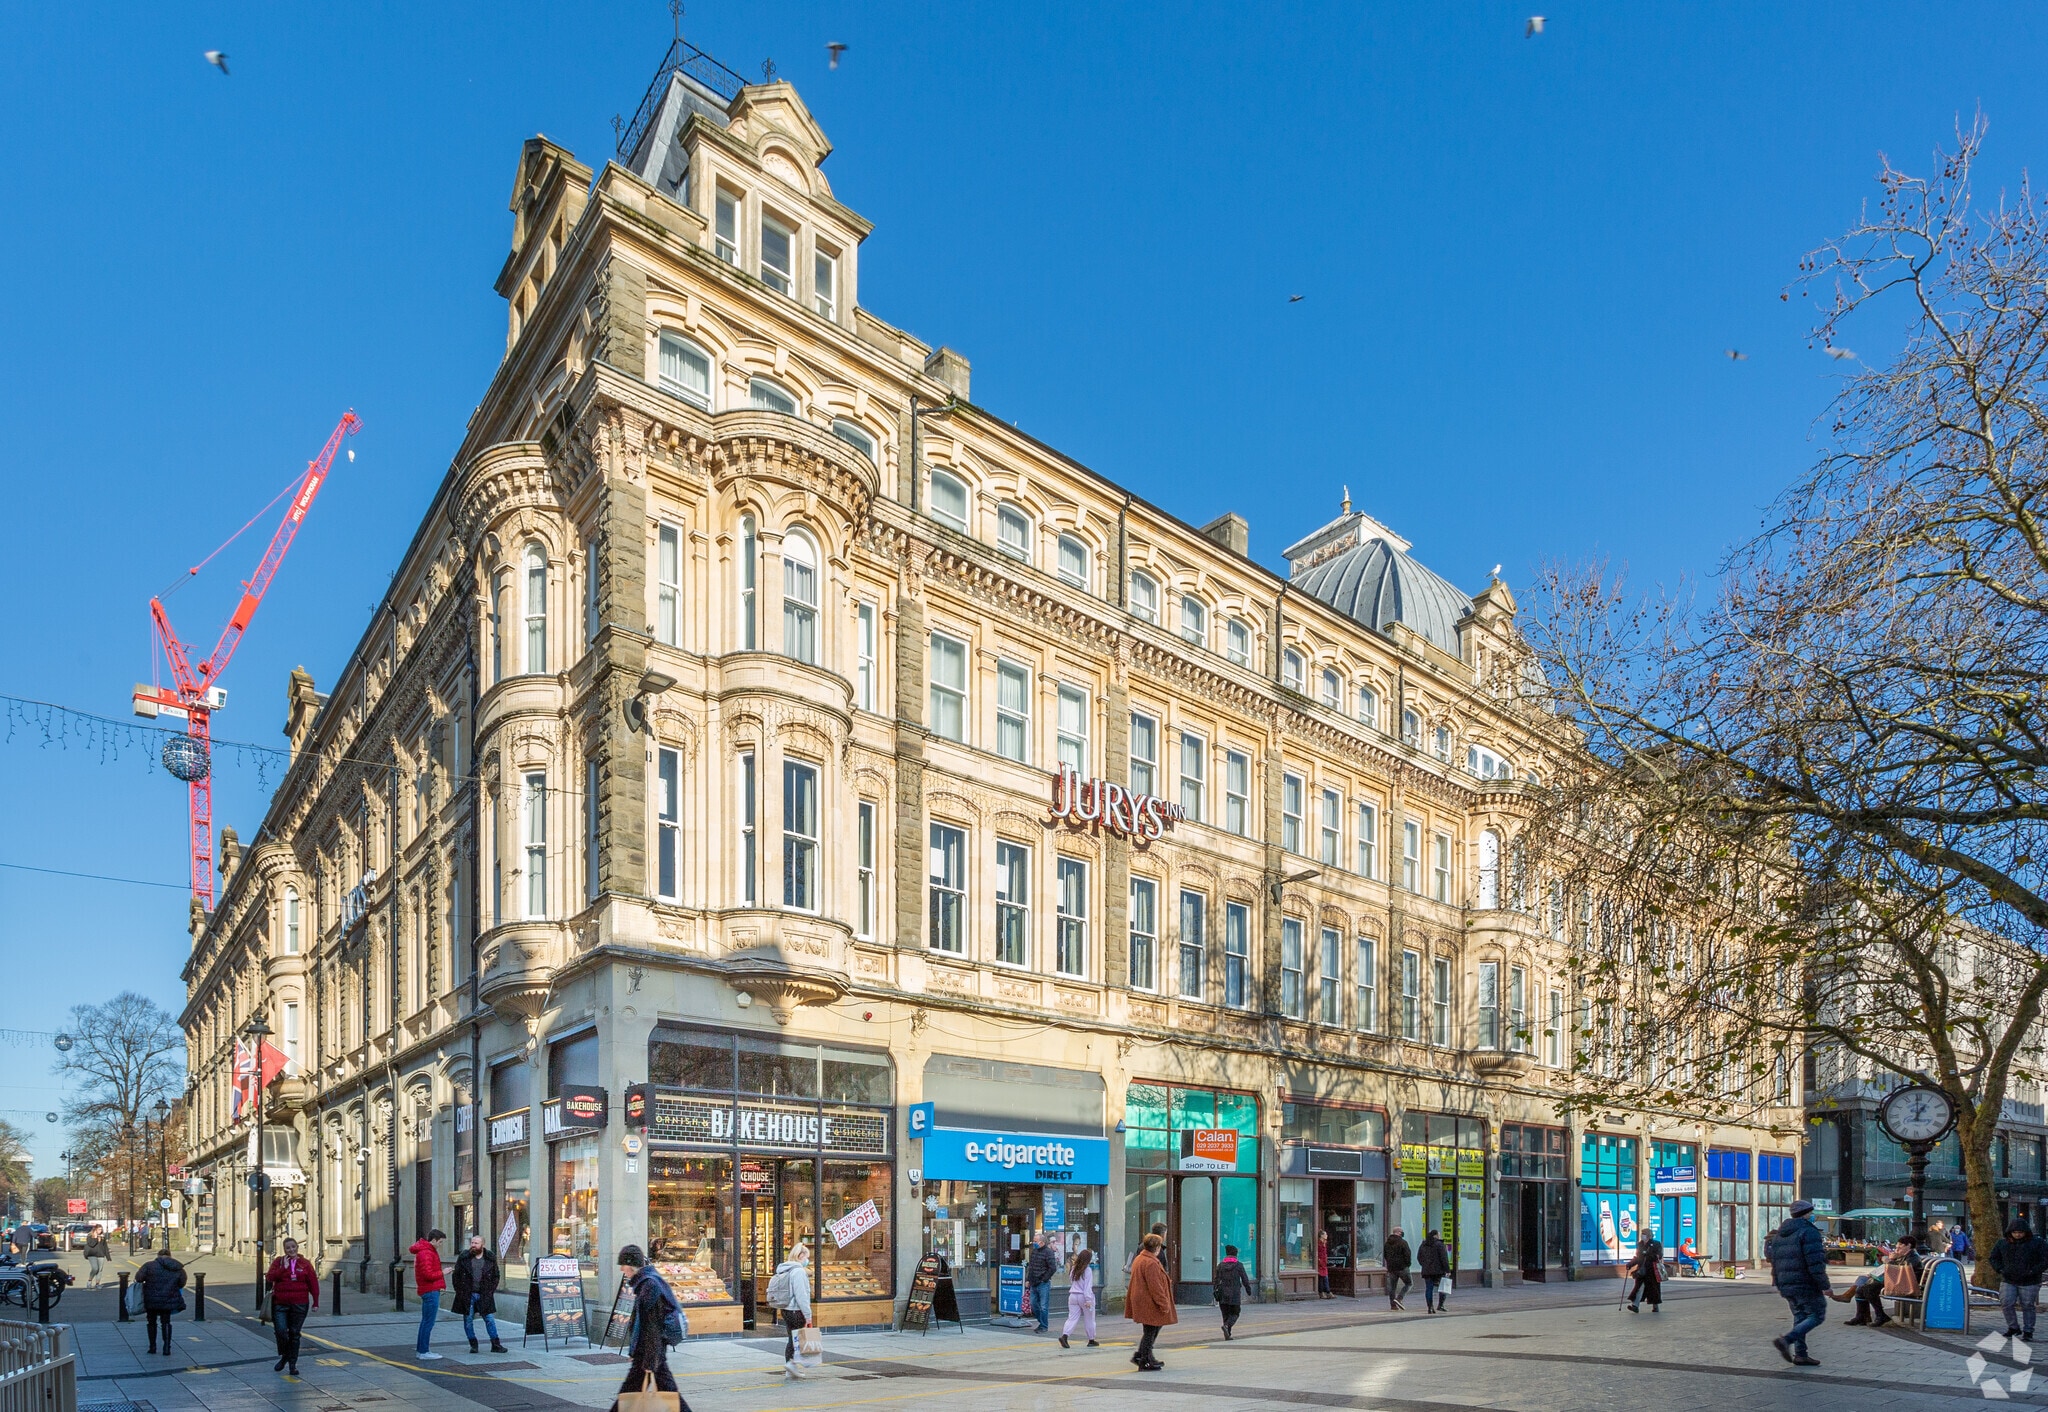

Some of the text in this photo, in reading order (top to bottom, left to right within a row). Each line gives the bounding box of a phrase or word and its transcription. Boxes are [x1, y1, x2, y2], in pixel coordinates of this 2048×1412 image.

[1050, 762, 1187, 841] JURYS INN
[566, 1101, 603, 1112] BAKEHOUSE
[655, 1115, 699, 1126] ORNISH
[711, 1109, 833, 1144] BAKEHOUSE
[911, 1109, 926, 1130] e
[965, 1137, 1075, 1168] e-cigarette
[1035, 1170, 1074, 1180] DIRECT
[832, 1201, 873, 1231] OPENING OFFER
[835, 1207, 876, 1242] 25% OFF
[540, 1264, 577, 1272] 25% OFF
